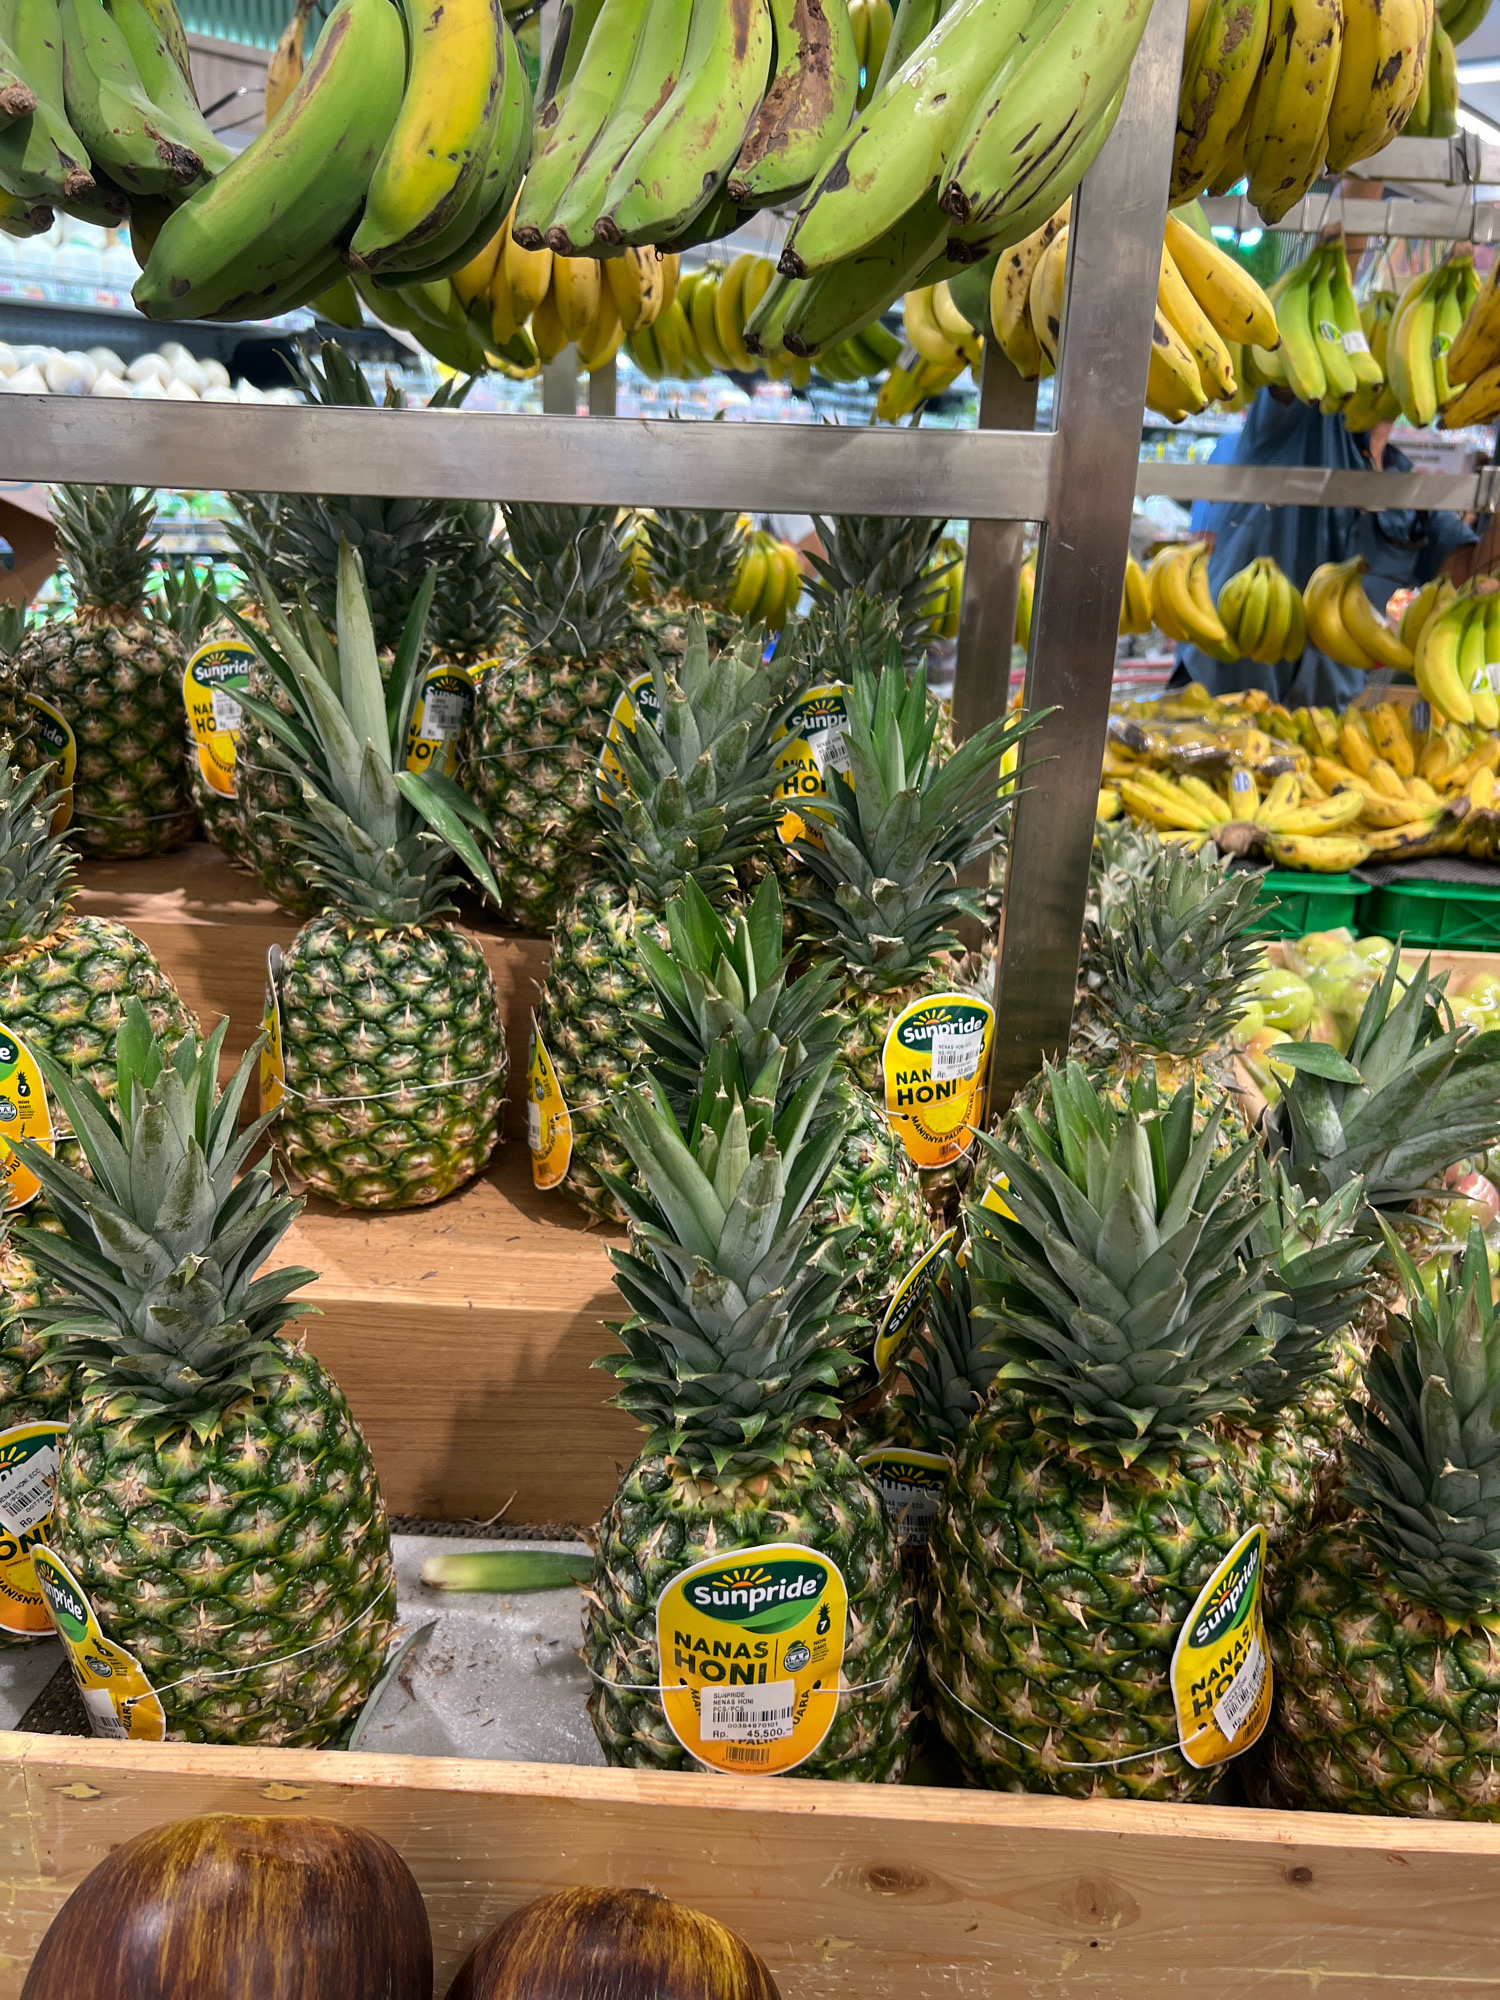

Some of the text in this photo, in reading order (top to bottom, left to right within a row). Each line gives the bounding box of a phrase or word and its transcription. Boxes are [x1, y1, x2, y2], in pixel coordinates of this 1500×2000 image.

[196, 717, 217, 733] HO
[792, 713, 847, 730] Sunpr
[904, 1016, 982, 1043] Sunpride
[896, 1069, 932, 1085] NAN
[897, 1080, 956, 1106] HONI
[911, 1115, 943, 1144] MANISNYA
[15, 1478, 29, 1490] HONI
[20, 1513, 36, 1528] Rp.
[0, 1523, 51, 1560] ONI
[694, 1575, 817, 1612] Sunpride
[1196, 1548, 1258, 1643] Sunpride
[675, 1630, 769, 1659] NANAS
[674, 1648, 767, 1685] HONI
[1191, 1625, 1250, 1697] NANAS
[793, 1689, 810, 1727] UARA
[712, 1730, 728, 1739] Rp.
